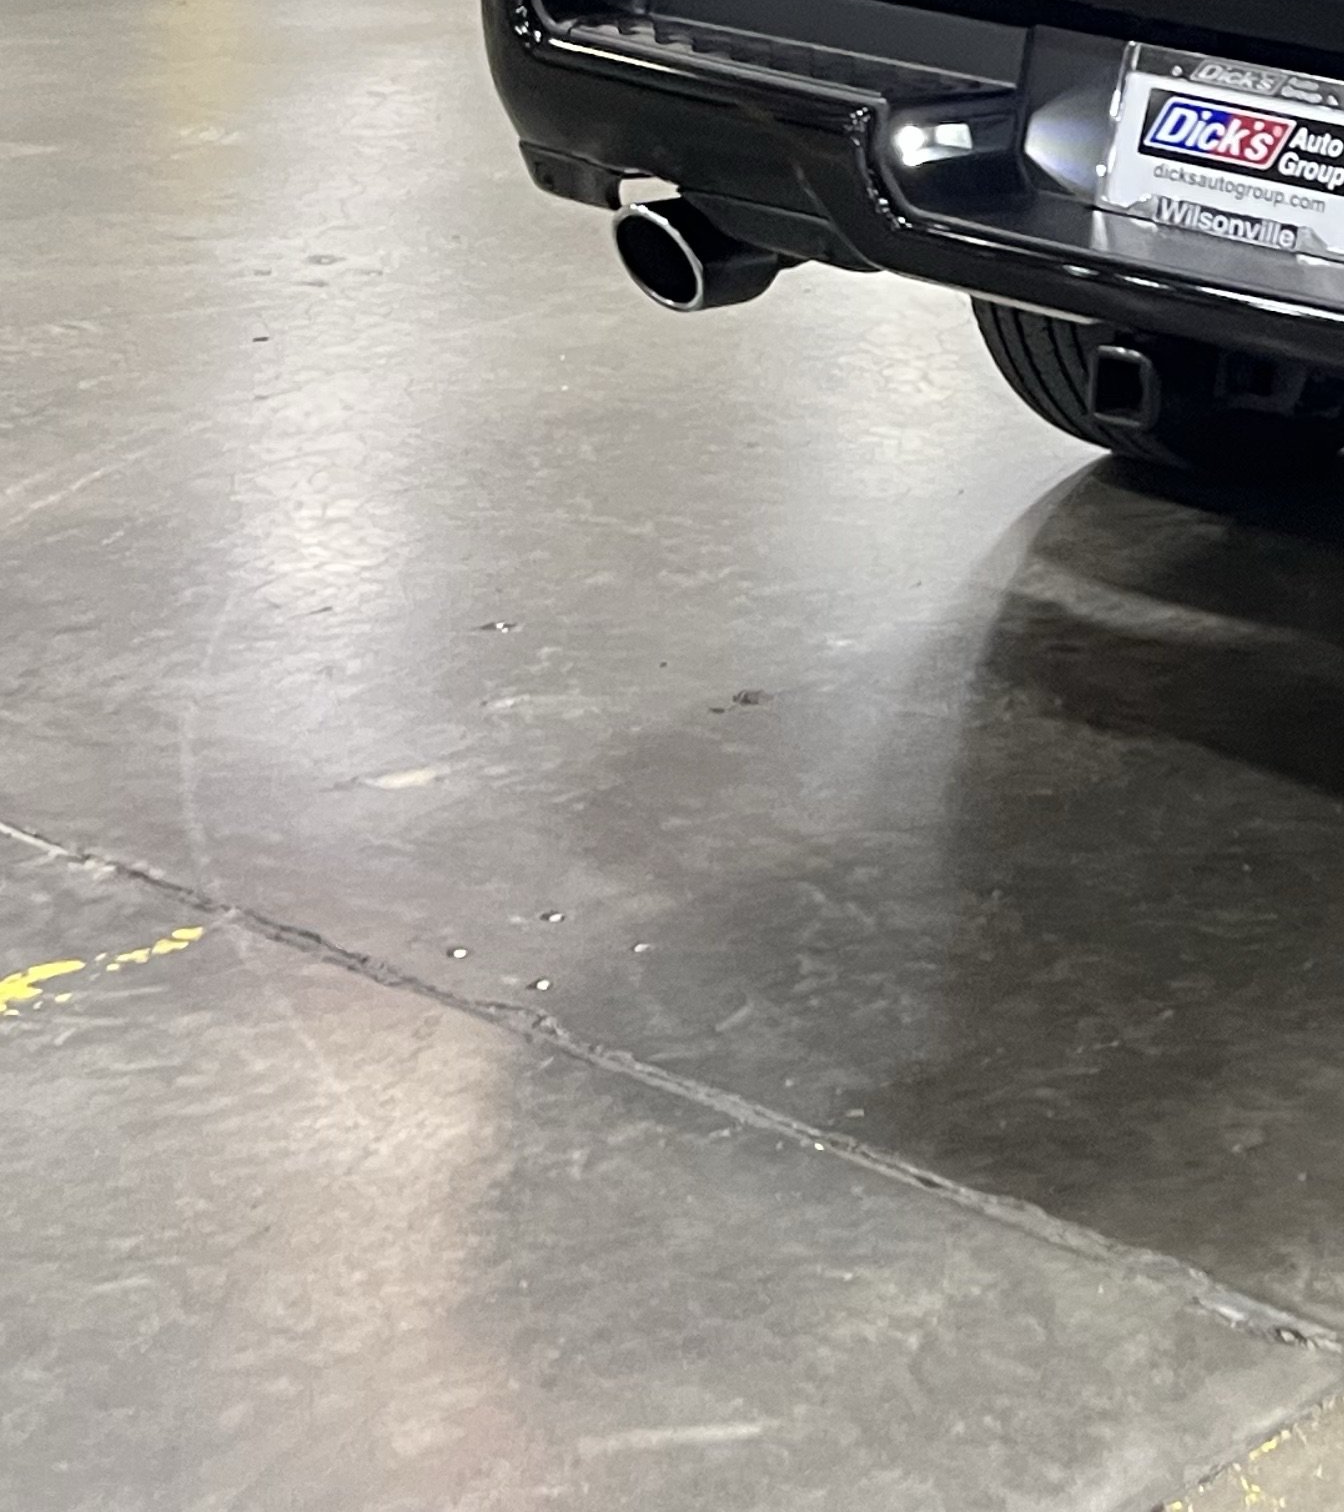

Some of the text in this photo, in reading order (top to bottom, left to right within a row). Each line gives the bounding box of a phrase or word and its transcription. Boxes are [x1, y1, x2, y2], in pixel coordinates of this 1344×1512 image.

[1154, 104, 1344, 162] Dick's Auto
[1152, 162, 1327, 214] dicksautogroup.com
[1158, 196, 1296, 249] Wilsonville
